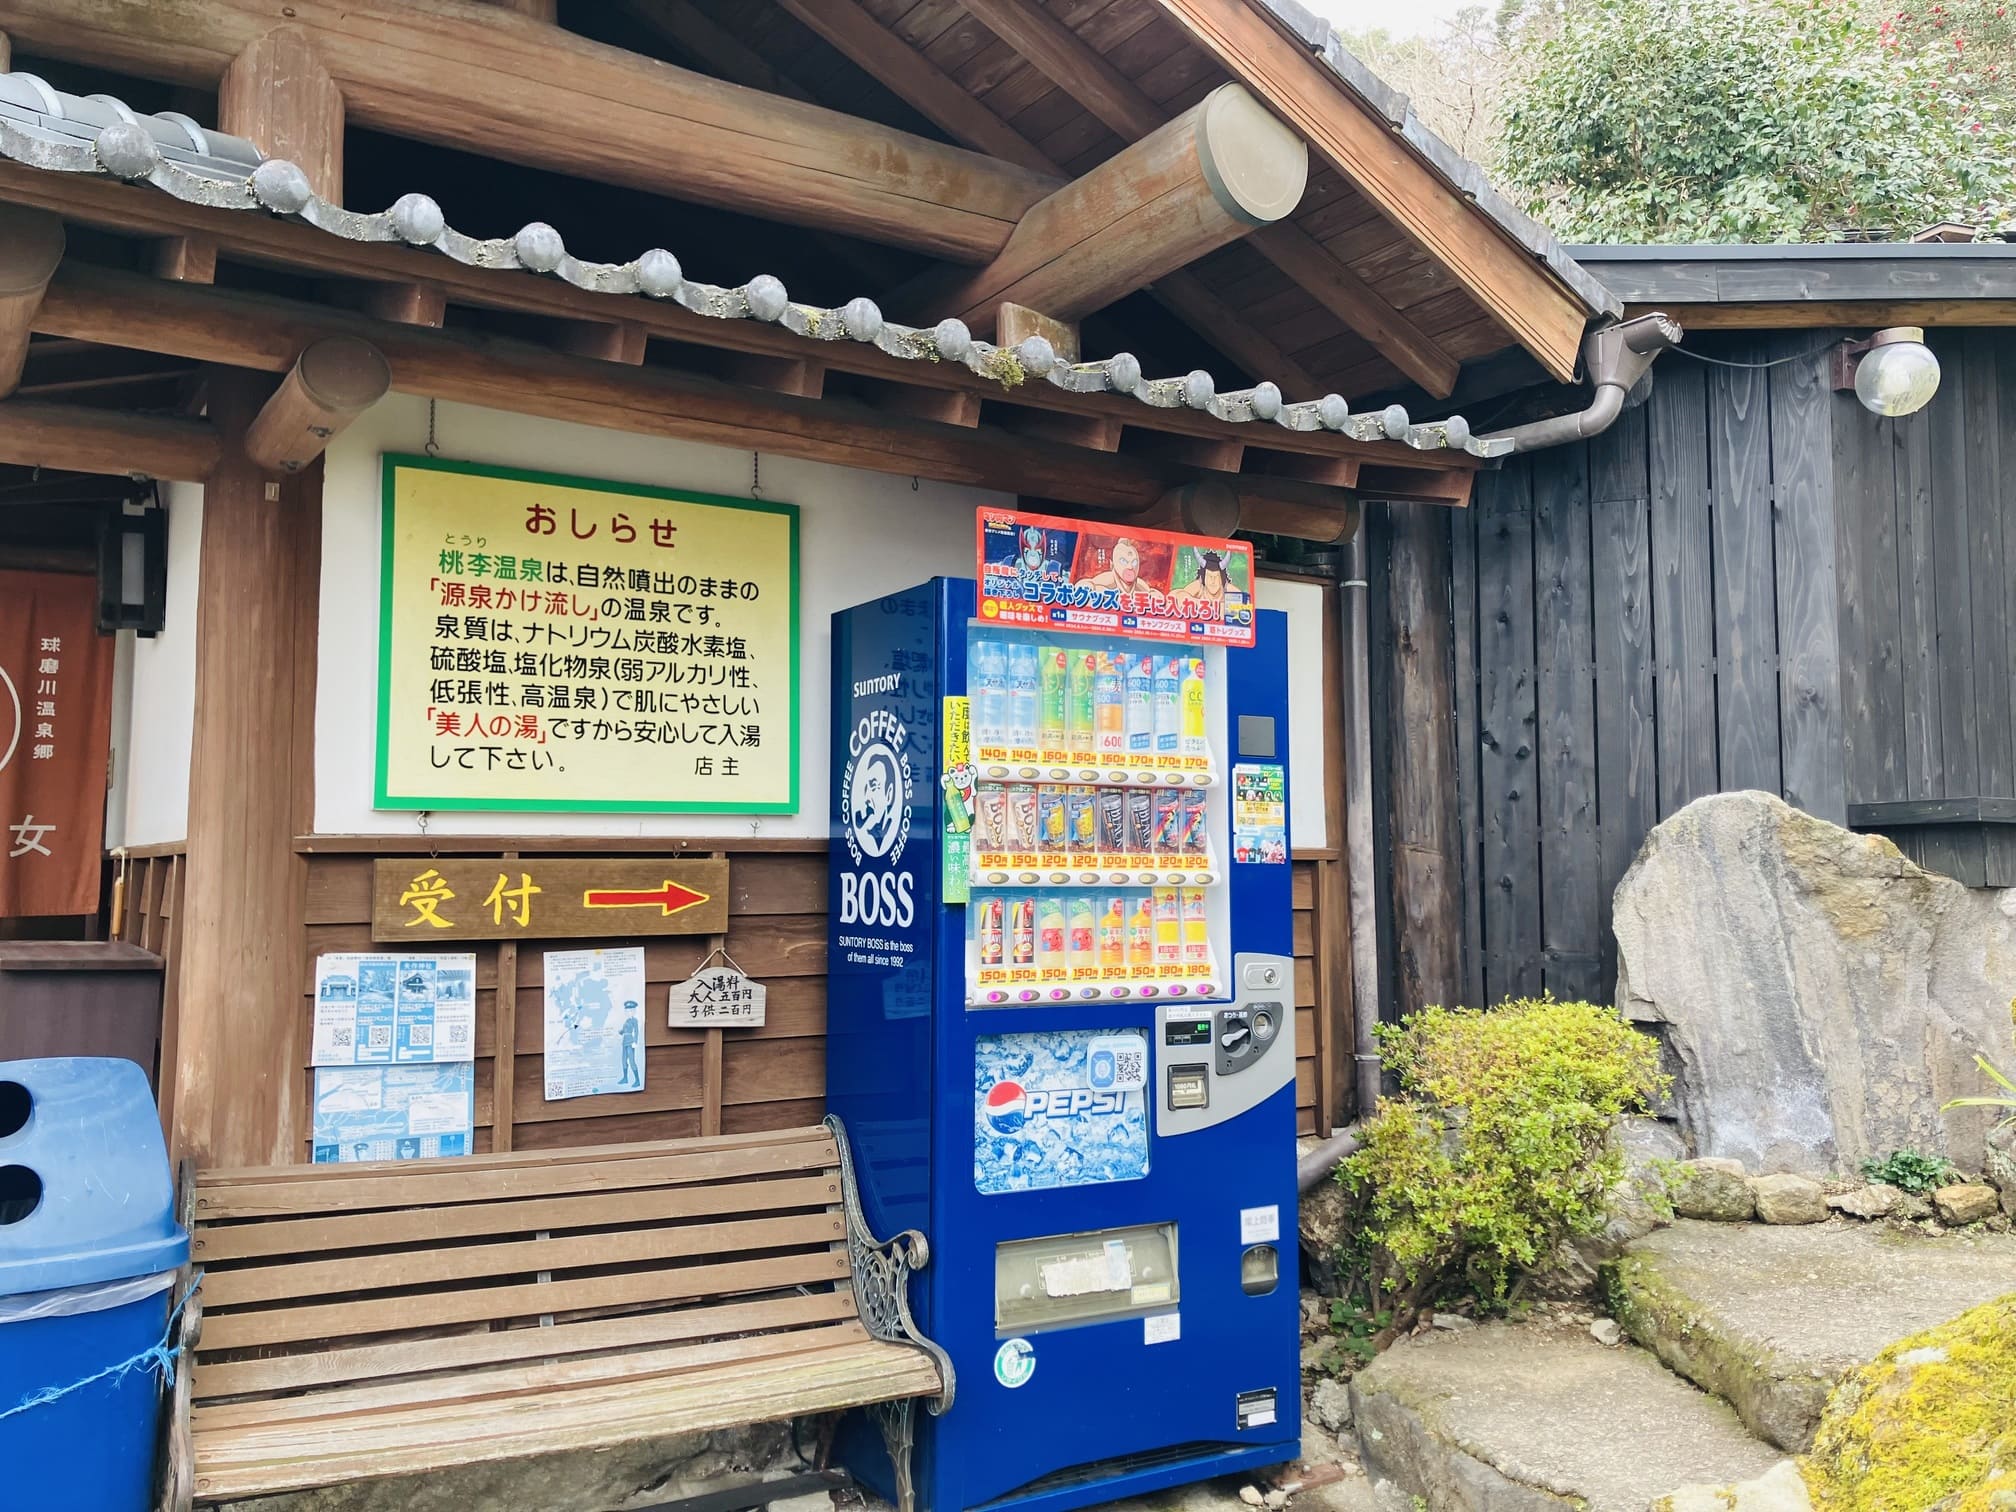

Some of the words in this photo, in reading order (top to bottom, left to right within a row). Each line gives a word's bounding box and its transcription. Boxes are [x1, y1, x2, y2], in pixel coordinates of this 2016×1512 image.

[444, 532, 488, 549] とうり
[524, 503, 678, 549] おしらせ
[438, 549, 760, 601] 桃李温泉は、自然噴出のままの
[430, 577, 721, 628] 「源泉かけ流し」の温泉です。
[434, 613, 756, 660] 泉質は、ナトリウム炭酸水素塩、
[33, 636, 61, 760] 球磨川温泉郷
[853, 672, 901, 699] SUNTORY
[427, 707, 761, 747] 「美人の湯」ですから安心して入湯
[849, 710, 906, 757] COFFEE
[430, 745, 566, 772] して下さい。
[900, 752, 912, 800] BOSS
[841, 761, 854, 824] COFFEE
[10, 814, 56, 858] 女
[844, 826, 862, 867] BOSS
[890, 806, 912, 867] COFFEE
[400, 868, 542, 928] 受付
[839, 871, 914, 928] BOSS
[838, 936, 866, 948] SUNTORY
[867, 938, 884, 950] BOSS
[884, 940, 890, 951] is
[890, 940, 899, 952] the
[900, 940, 914, 952] boss
[848, 952, 853, 962] of
[854, 952, 866, 963] them
[875, 954, 889, 966] since
[890, 956, 904, 968] 1992
[688, 990, 716, 1004] 大人
[719, 989, 752, 1002] 五百円
[695, 976, 740, 992] 入湯料
[690, 1004, 716, 1018] 子供
[719, 1004, 752, 1015] 二百円
[1024, 1088, 1126, 1120] PEPSI
